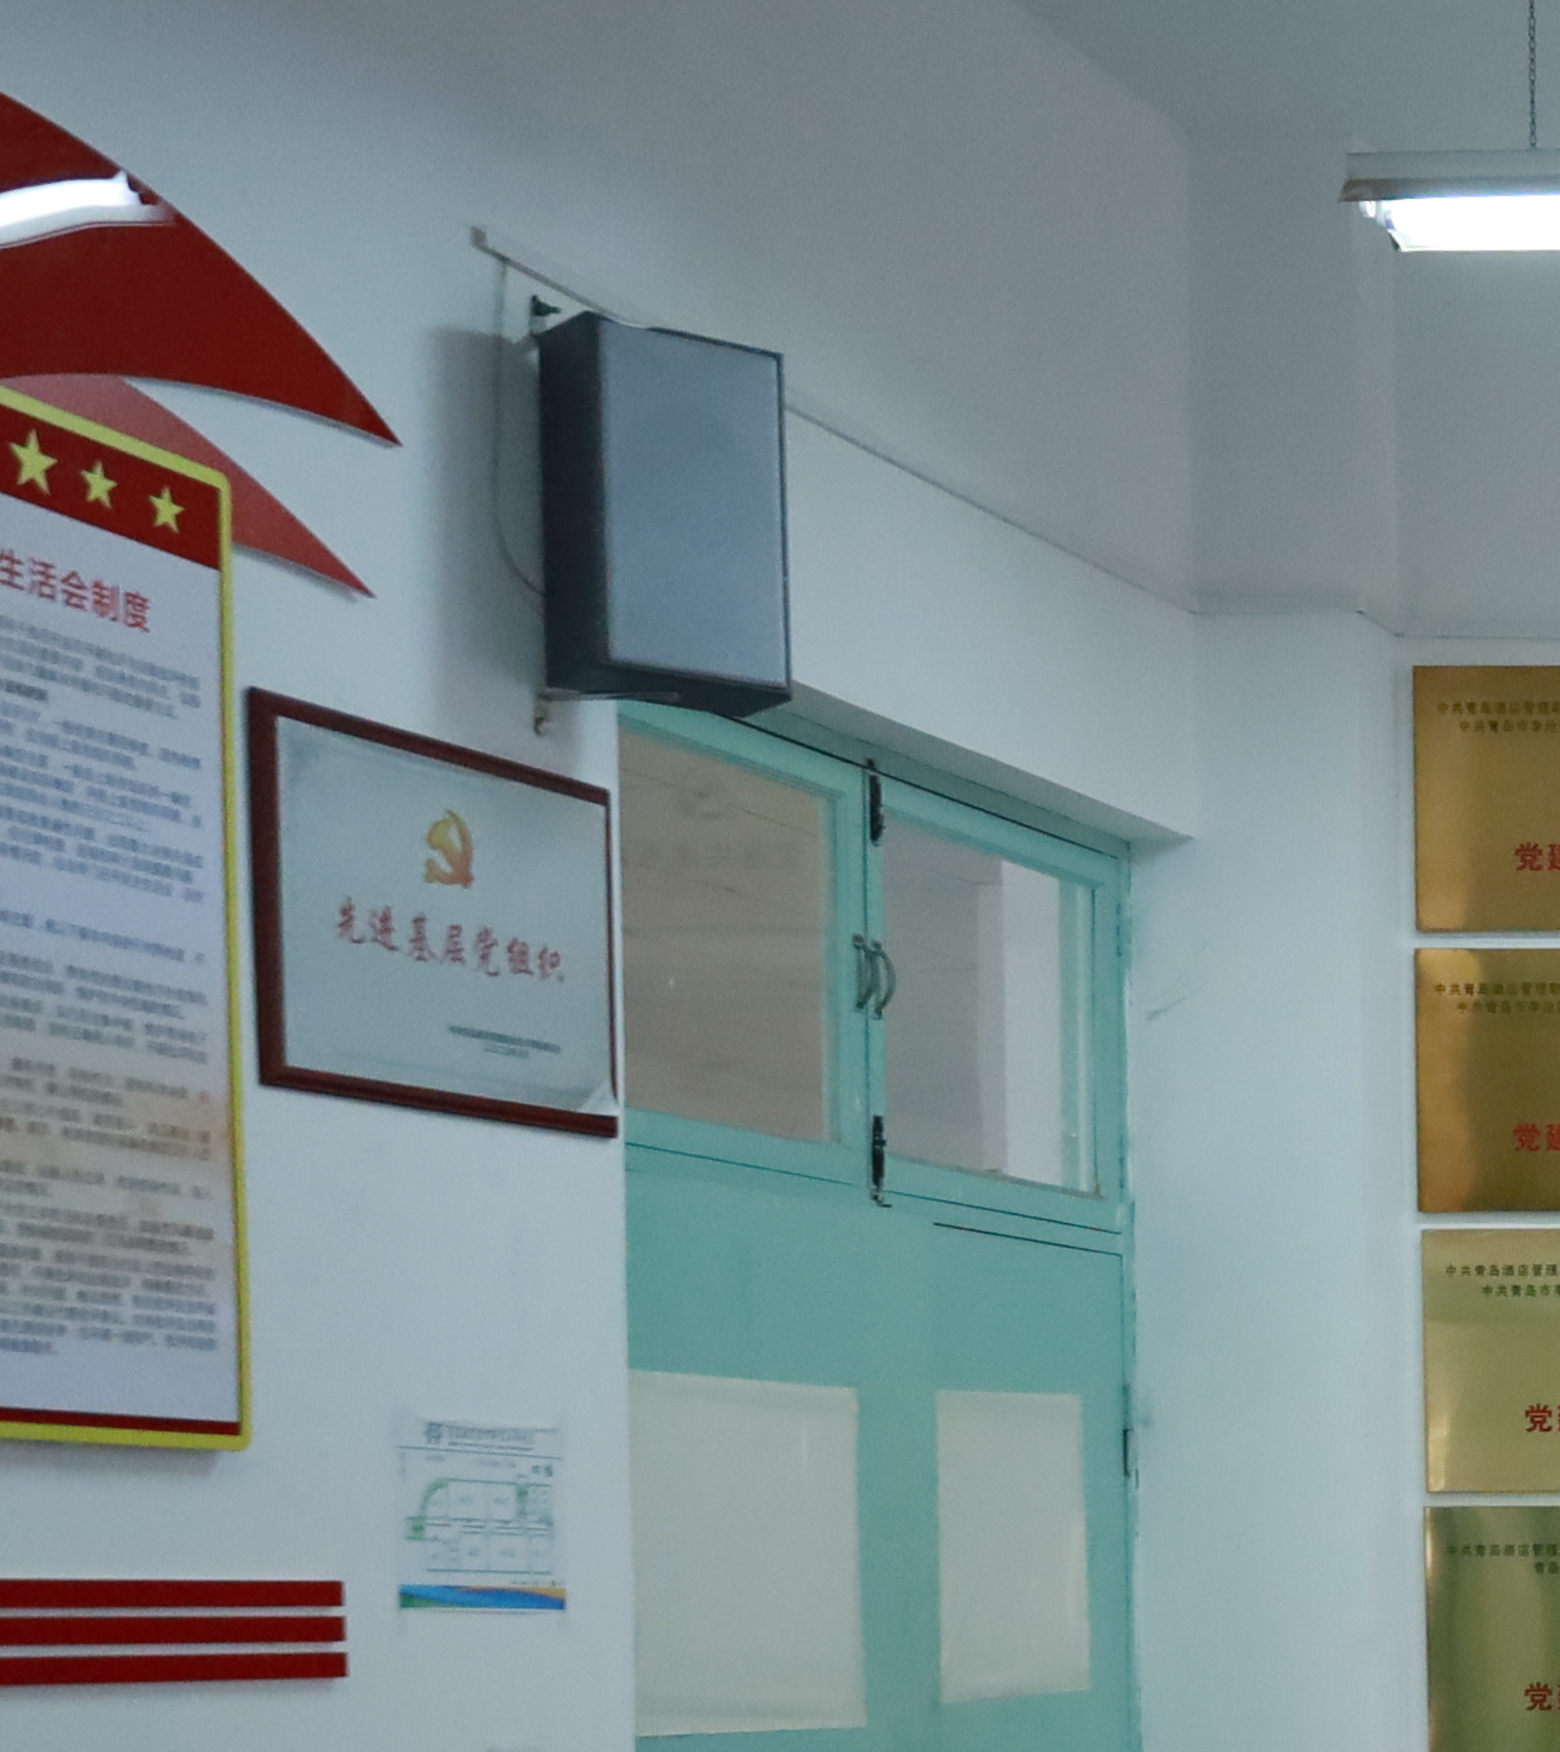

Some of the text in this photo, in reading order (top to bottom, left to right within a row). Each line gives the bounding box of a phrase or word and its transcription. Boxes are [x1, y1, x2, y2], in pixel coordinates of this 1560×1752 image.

[337, 896, 565, 983] 先进基层党组织
